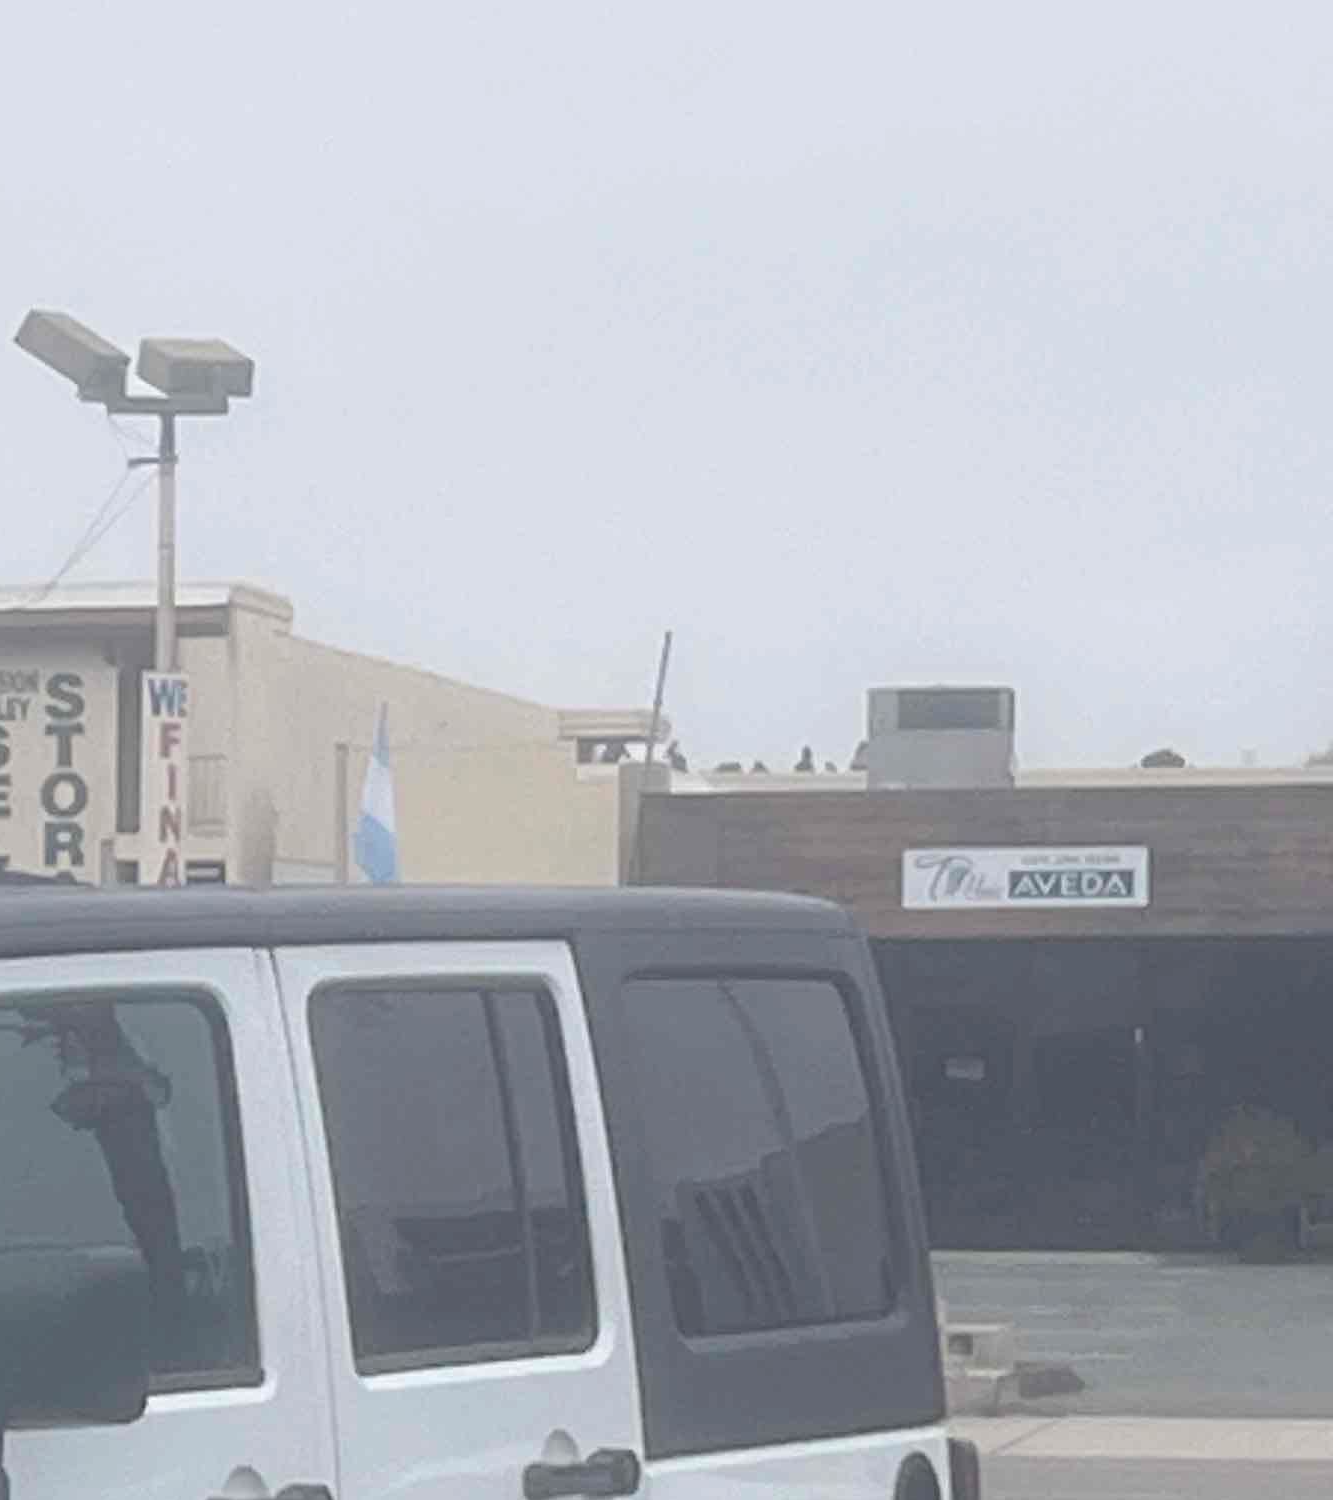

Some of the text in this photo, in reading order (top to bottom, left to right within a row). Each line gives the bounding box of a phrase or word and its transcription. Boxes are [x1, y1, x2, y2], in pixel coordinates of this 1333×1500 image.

[148, 678, 187, 718] WE
[41, 673, 88, 879] STOR
[158, 722, 182, 887] FINA
[1013, 872, 1129, 898] AVEDA
